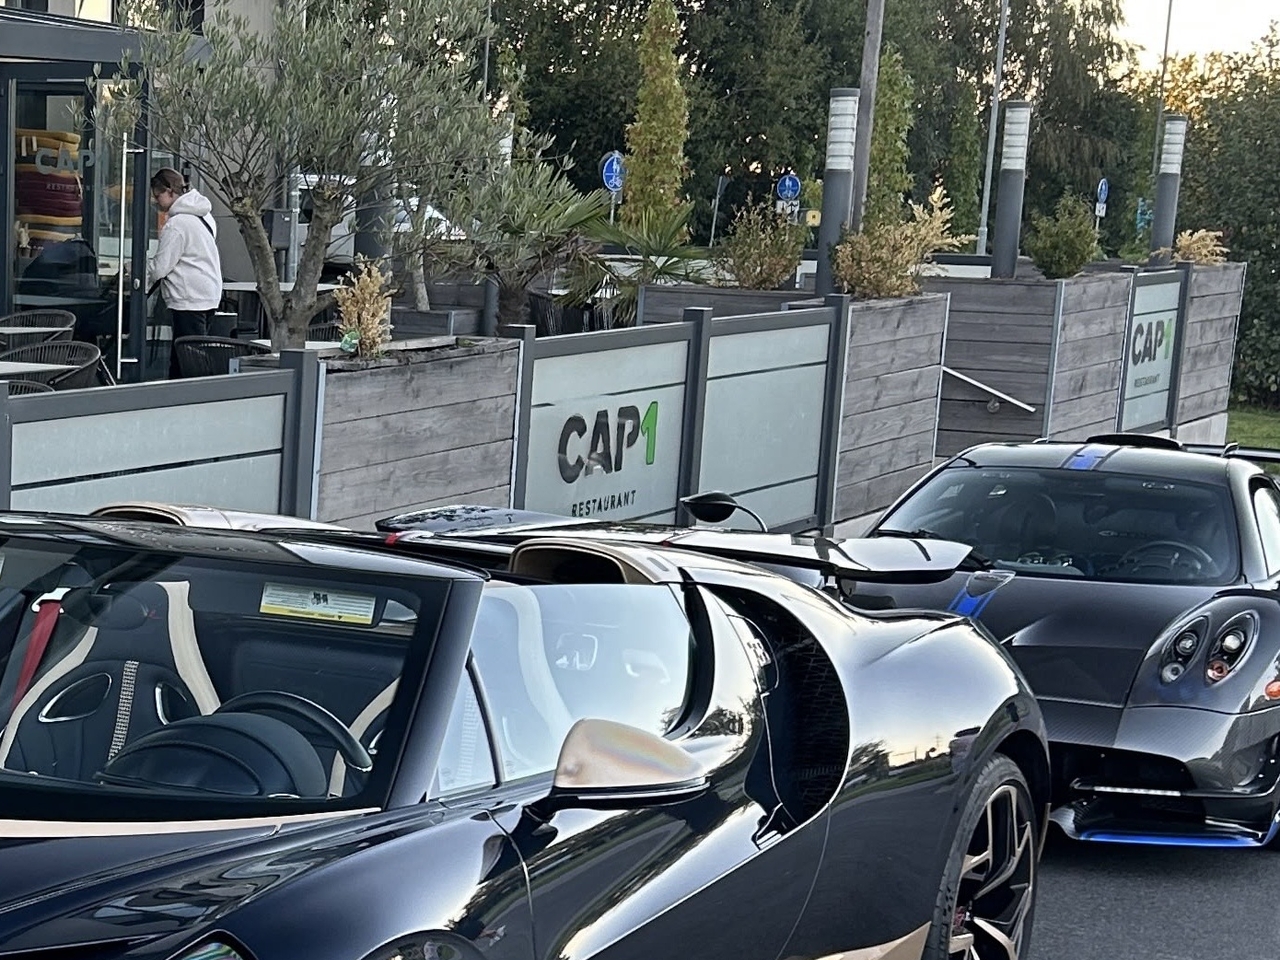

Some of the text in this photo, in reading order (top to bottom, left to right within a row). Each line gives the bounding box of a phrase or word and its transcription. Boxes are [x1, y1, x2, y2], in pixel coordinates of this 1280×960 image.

[1131, 318, 1173, 367] CAP1
[557, 400, 659, 484] CAP1
[571, 489, 637, 517] RESTAURANT
